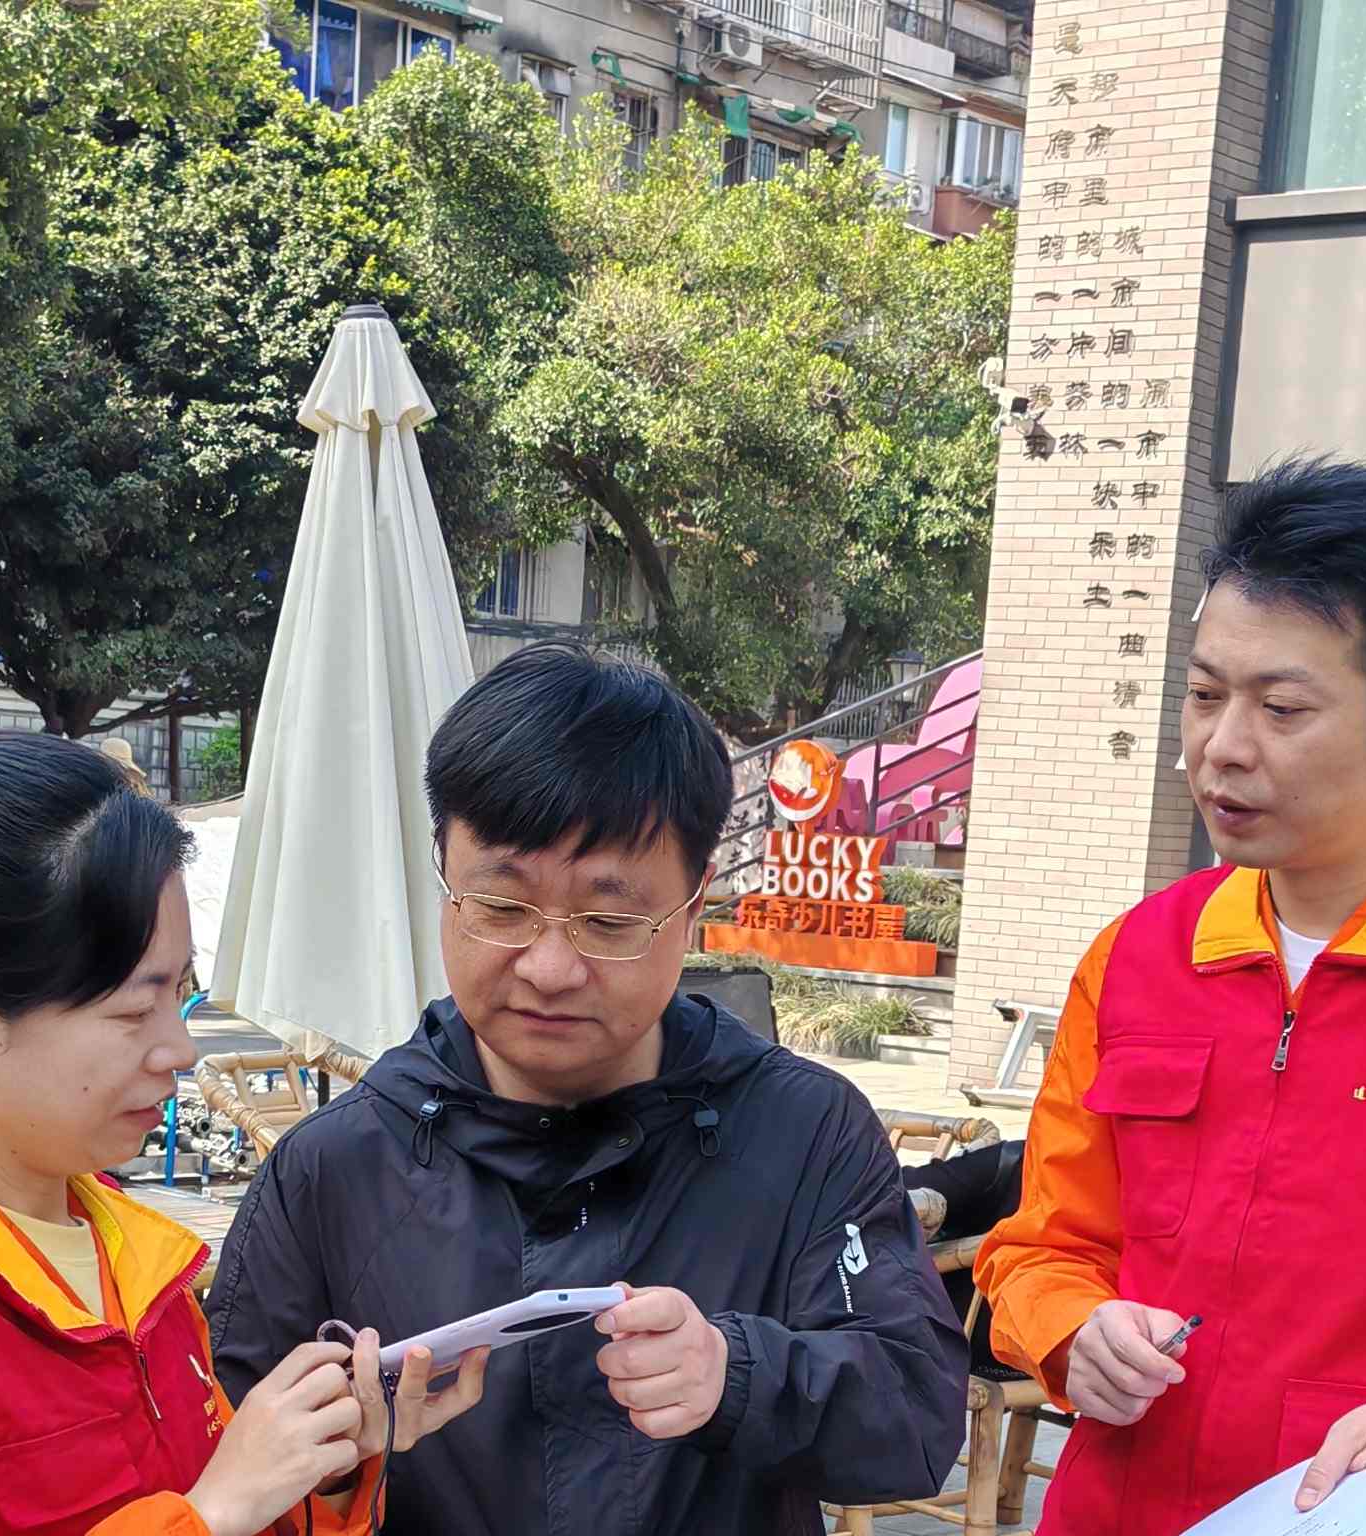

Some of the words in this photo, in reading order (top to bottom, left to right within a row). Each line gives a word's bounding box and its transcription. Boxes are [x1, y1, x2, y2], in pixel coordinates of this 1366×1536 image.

[764, 830, 877, 871] LUCKY
[761, 865, 875, 903] BOOKS
[737, 898, 907, 941] 乐奇少儿书屋
